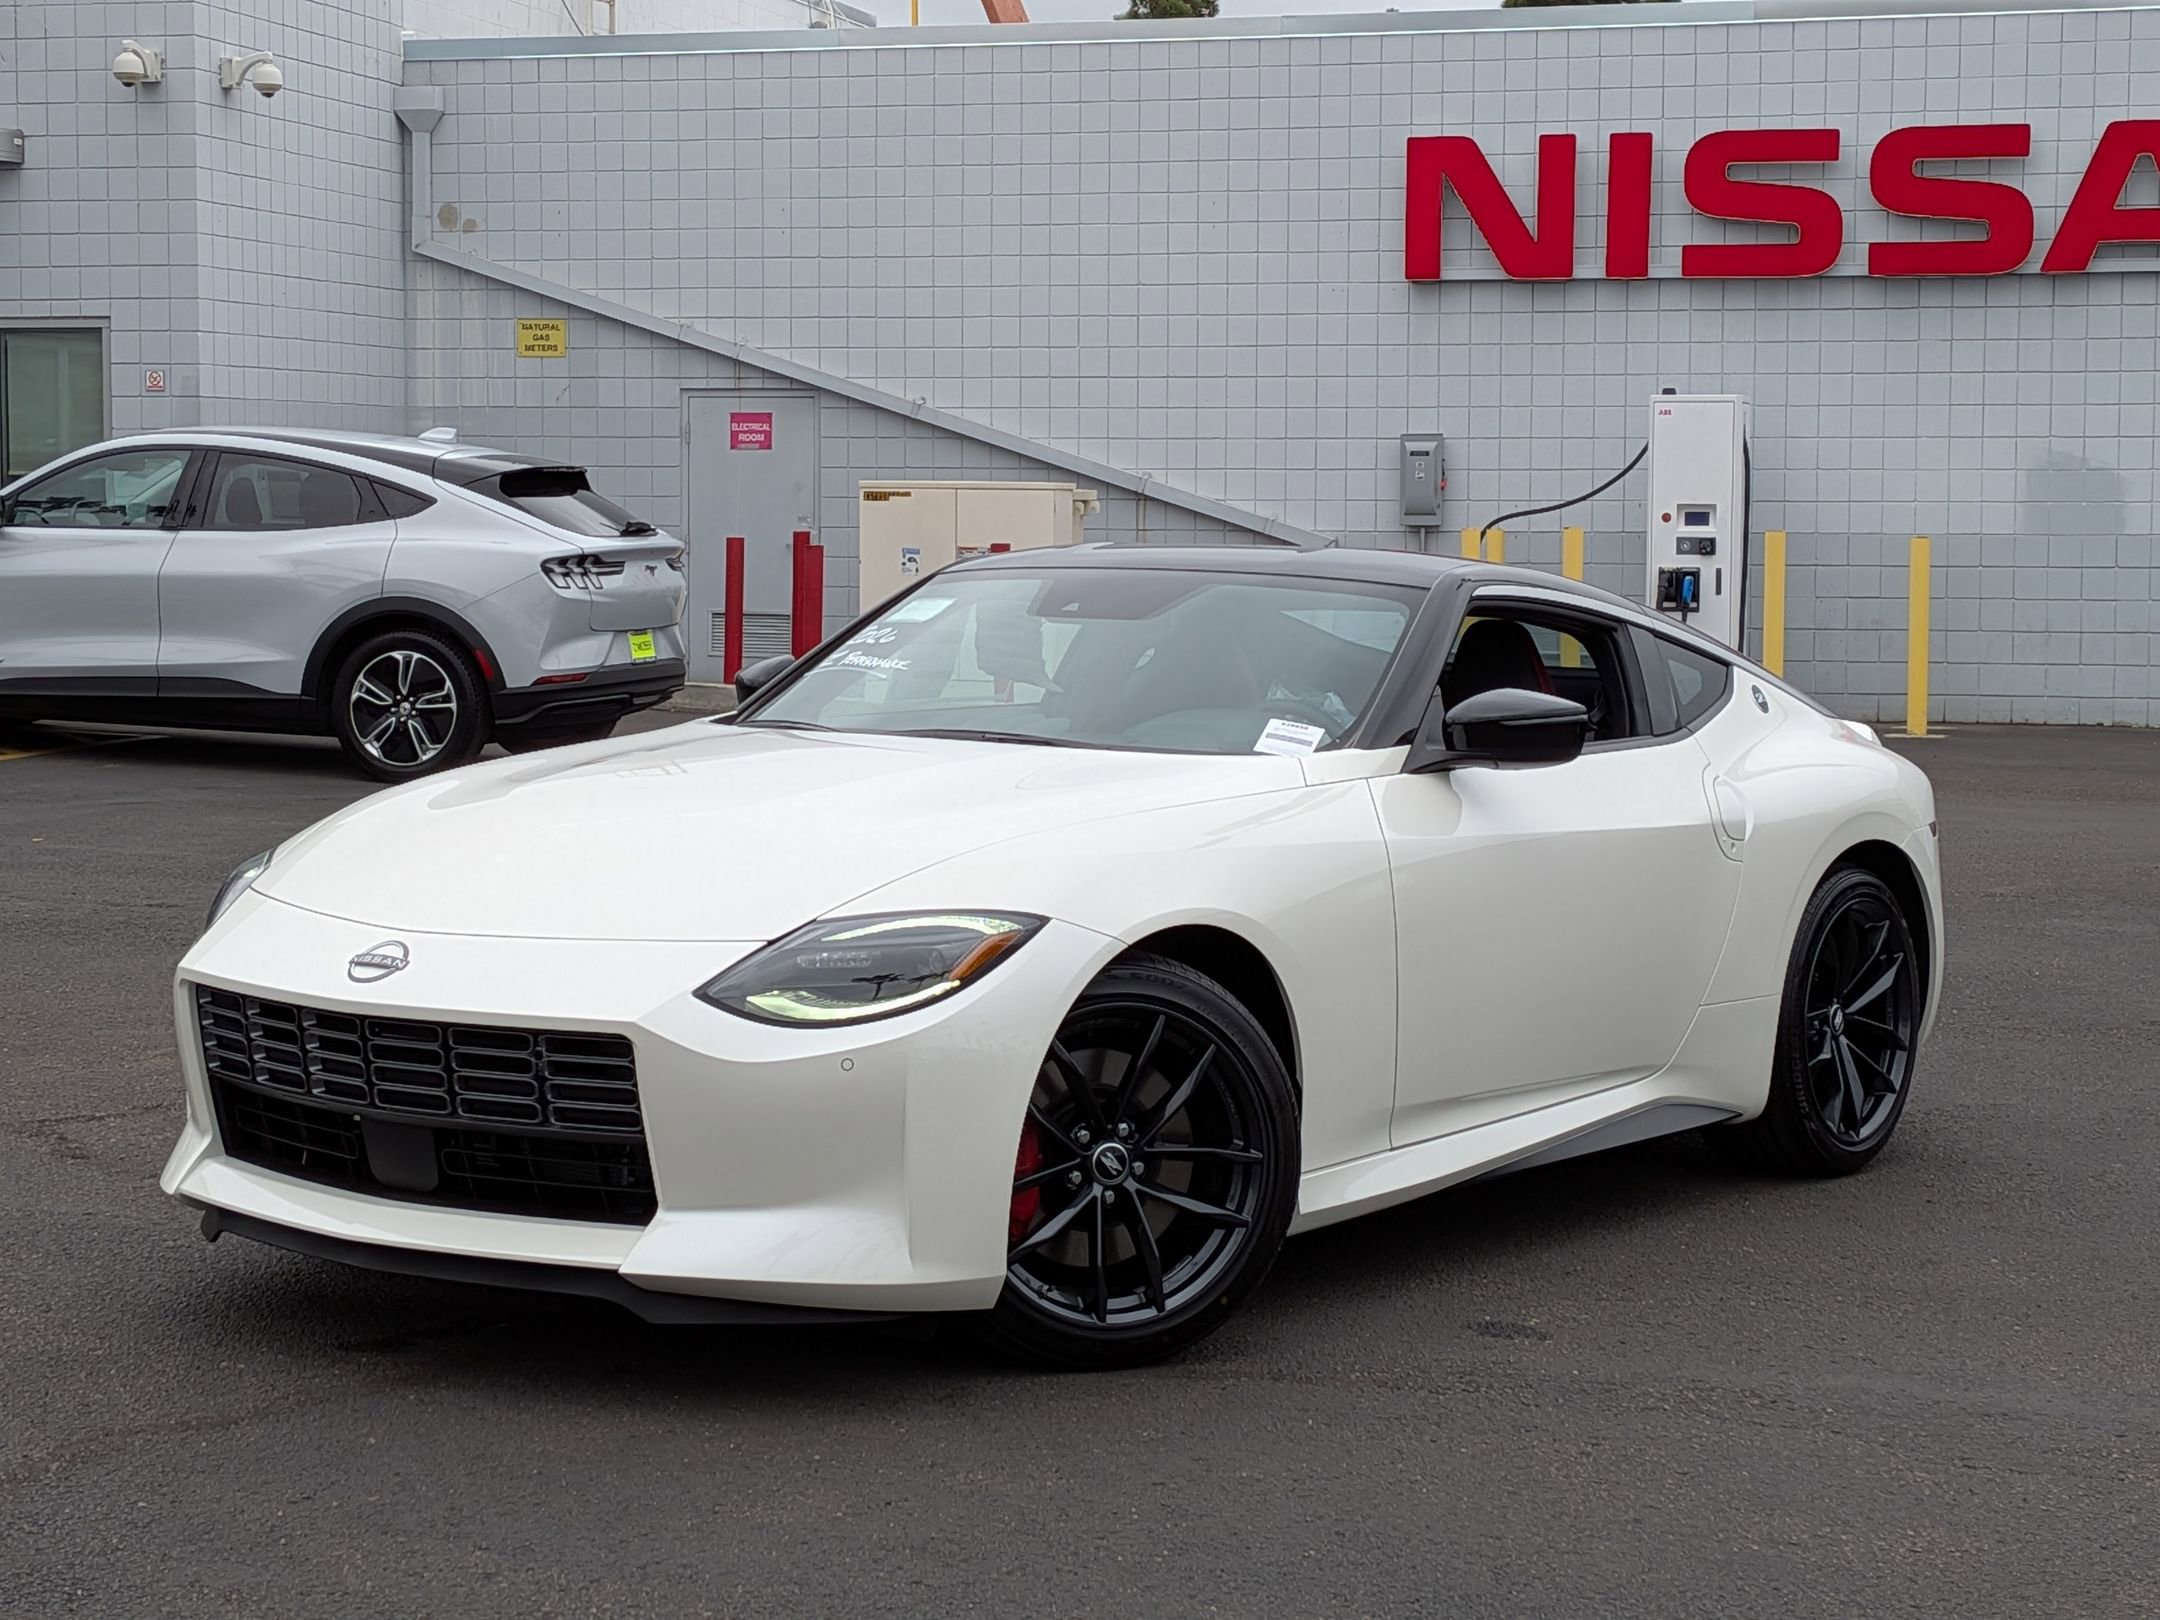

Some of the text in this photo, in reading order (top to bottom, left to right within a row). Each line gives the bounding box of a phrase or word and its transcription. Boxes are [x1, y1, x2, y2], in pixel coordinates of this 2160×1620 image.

[521, 323, 561, 331] NATURAL
[532, 333, 550, 341] GAS
[524, 344, 558, 352] METERS
[738, 433, 765, 442] ROOM
[351, 954, 406, 969] NISSAN
